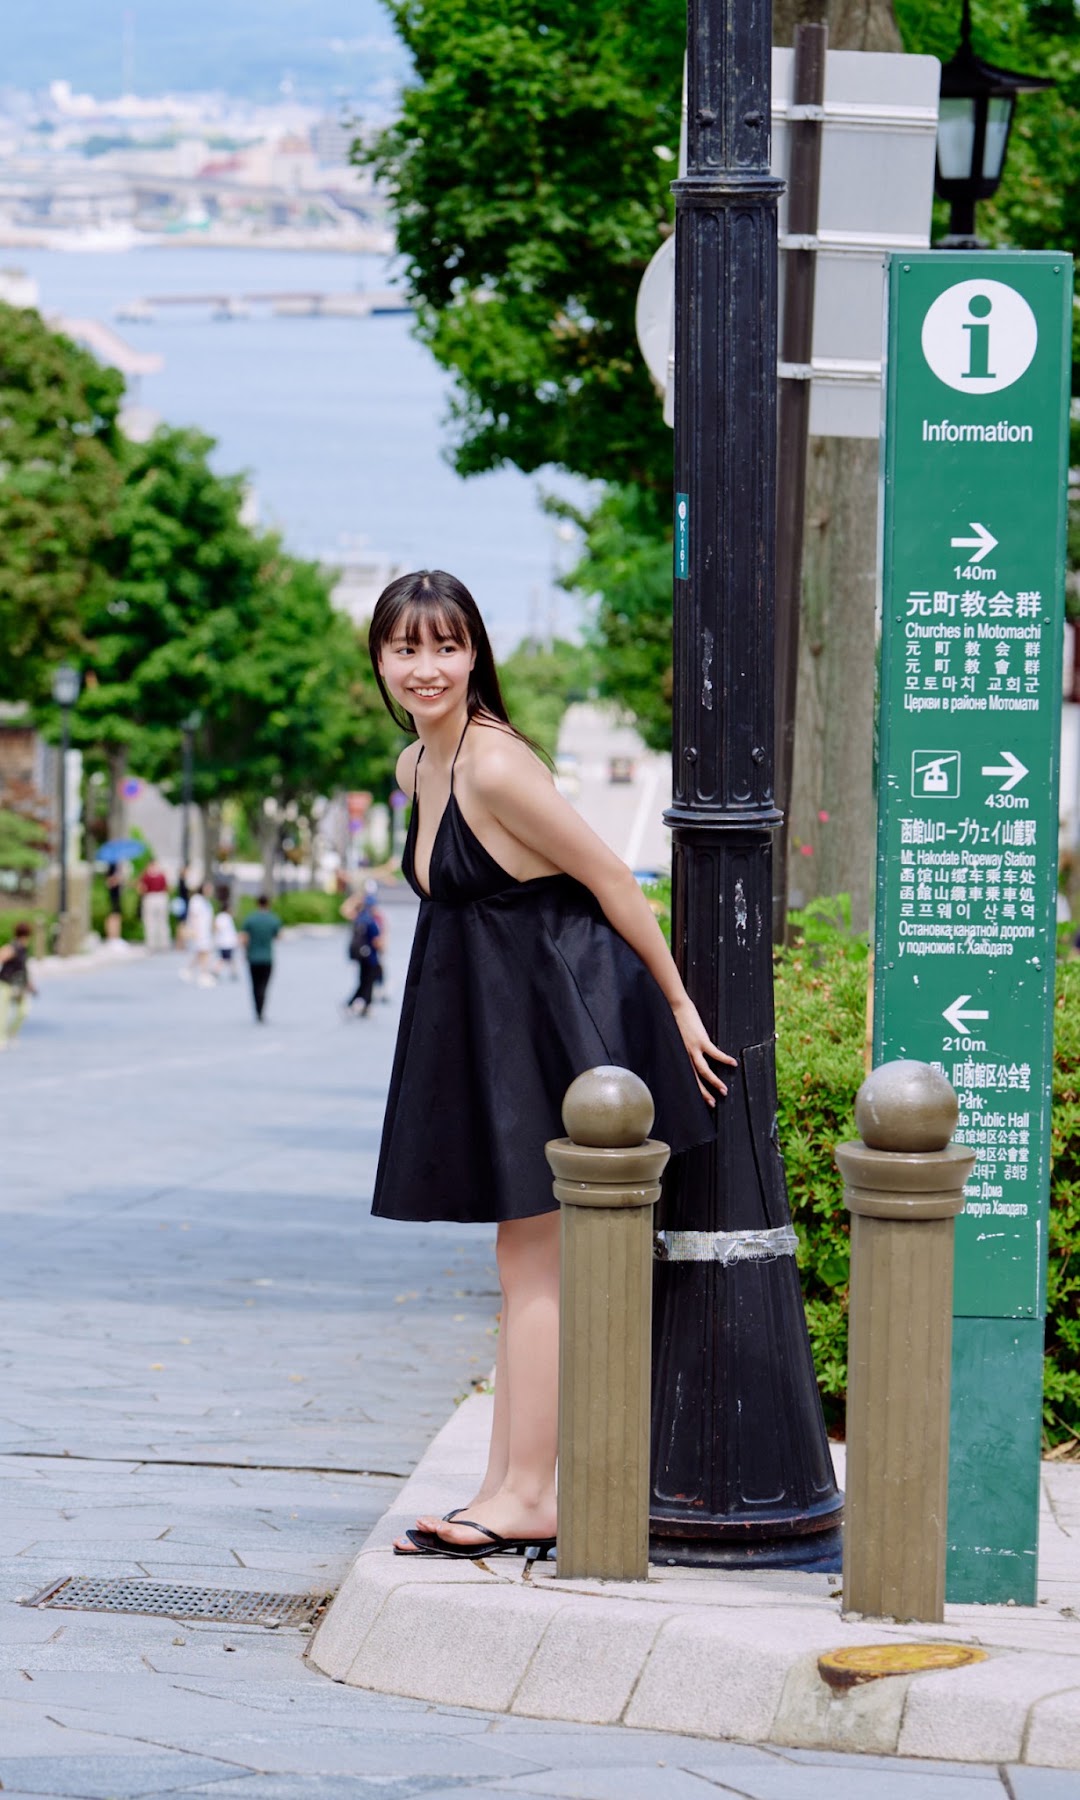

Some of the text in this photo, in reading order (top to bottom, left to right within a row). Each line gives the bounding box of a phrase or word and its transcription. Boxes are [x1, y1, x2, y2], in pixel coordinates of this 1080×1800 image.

[922, 419, 1033, 442] Information
[953, 565, 997, 581] 140m
[905, 590, 1043, 618] 元町教会群
[904, 622, 1042, 640] Churches in Motomachi
[903, 676, 1041, 694] 모토마치 교회군
[903, 694, 1040, 713] Церкви в районе Мотомати
[984, 794, 1030, 809] 430m
[900, 817, 1037, 846] 函館山ロープウェイ山麓駅
[916, 849, 960, 866] Hakodate
[961, 850, 1003, 870] Ropeway
[1004, 850, 1037, 868] Station
[899, 903, 1036, 921] 로프웨이 산록역
[898, 920, 1036, 941] Остановка канатной дороги
[898, 941, 906, 957] у
[906, 941, 956, 957] подножия
[966, 940, 1014, 957] Хакодатэ
[942, 1036, 987, 1052] 210m
[971, 1111, 1006, 1127] Public
[1007, 1112, 1030, 1128] Hall
[1003, 1163, 1028, 1181] 공회당
[981, 1181, 1003, 1200] Дома
[966, 1201, 992, 1218] округа
